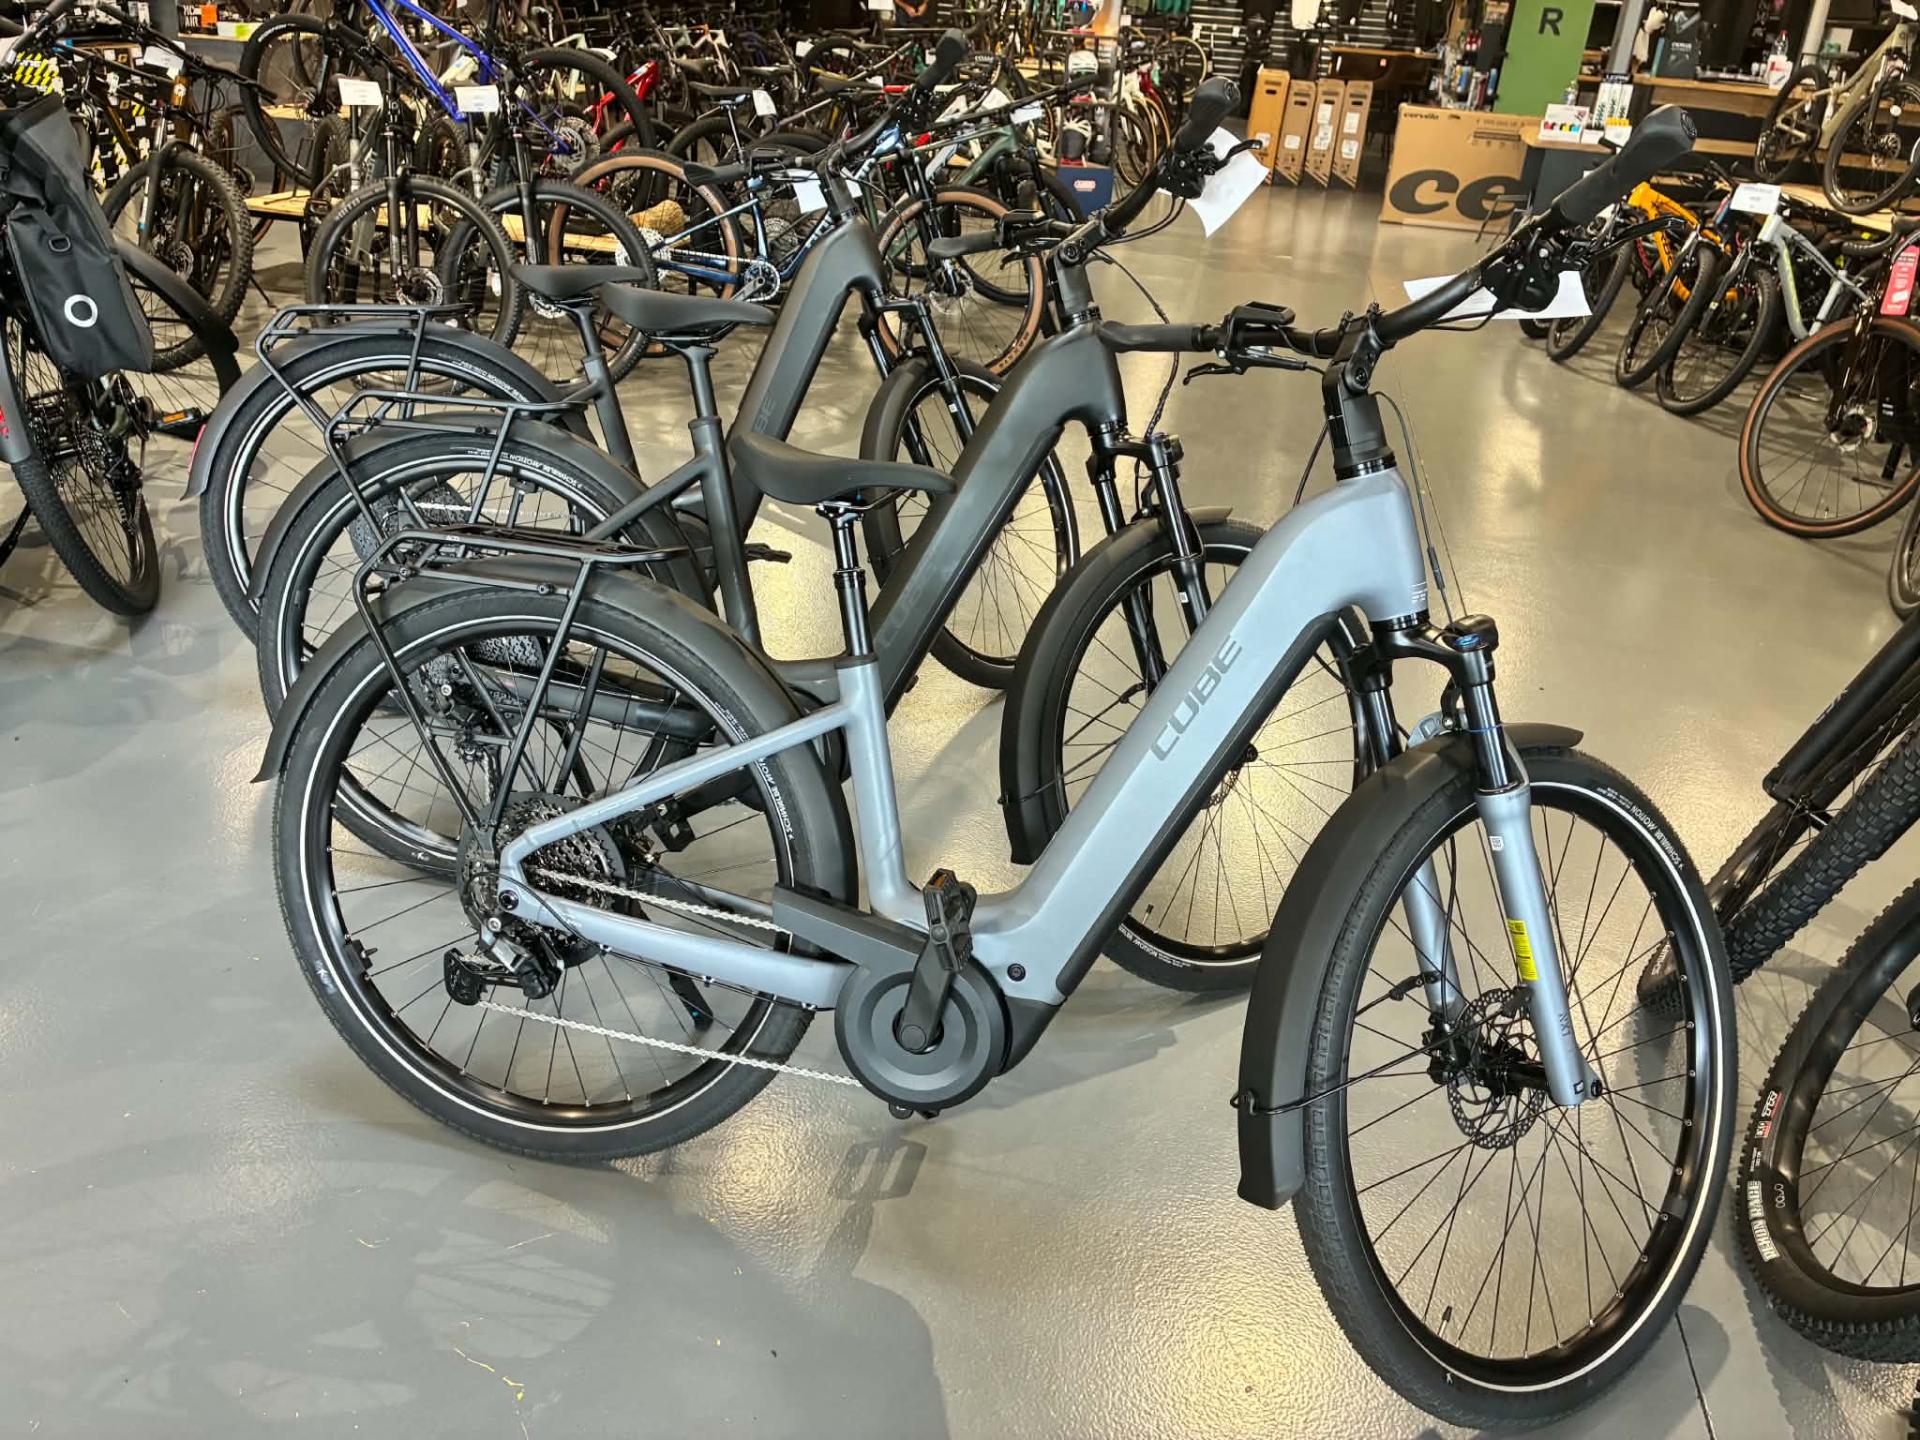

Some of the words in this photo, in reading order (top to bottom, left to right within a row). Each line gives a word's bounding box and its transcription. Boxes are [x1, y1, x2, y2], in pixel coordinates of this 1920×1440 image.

[1538, 7, 1563, 36] R
[1151, 634, 1243, 761] CUBE
[771, 786, 793, 833] SCHWALBE
[1629, 804, 1659, 831] MOTION
[1655, 829, 1682, 865] SCHWALBE
